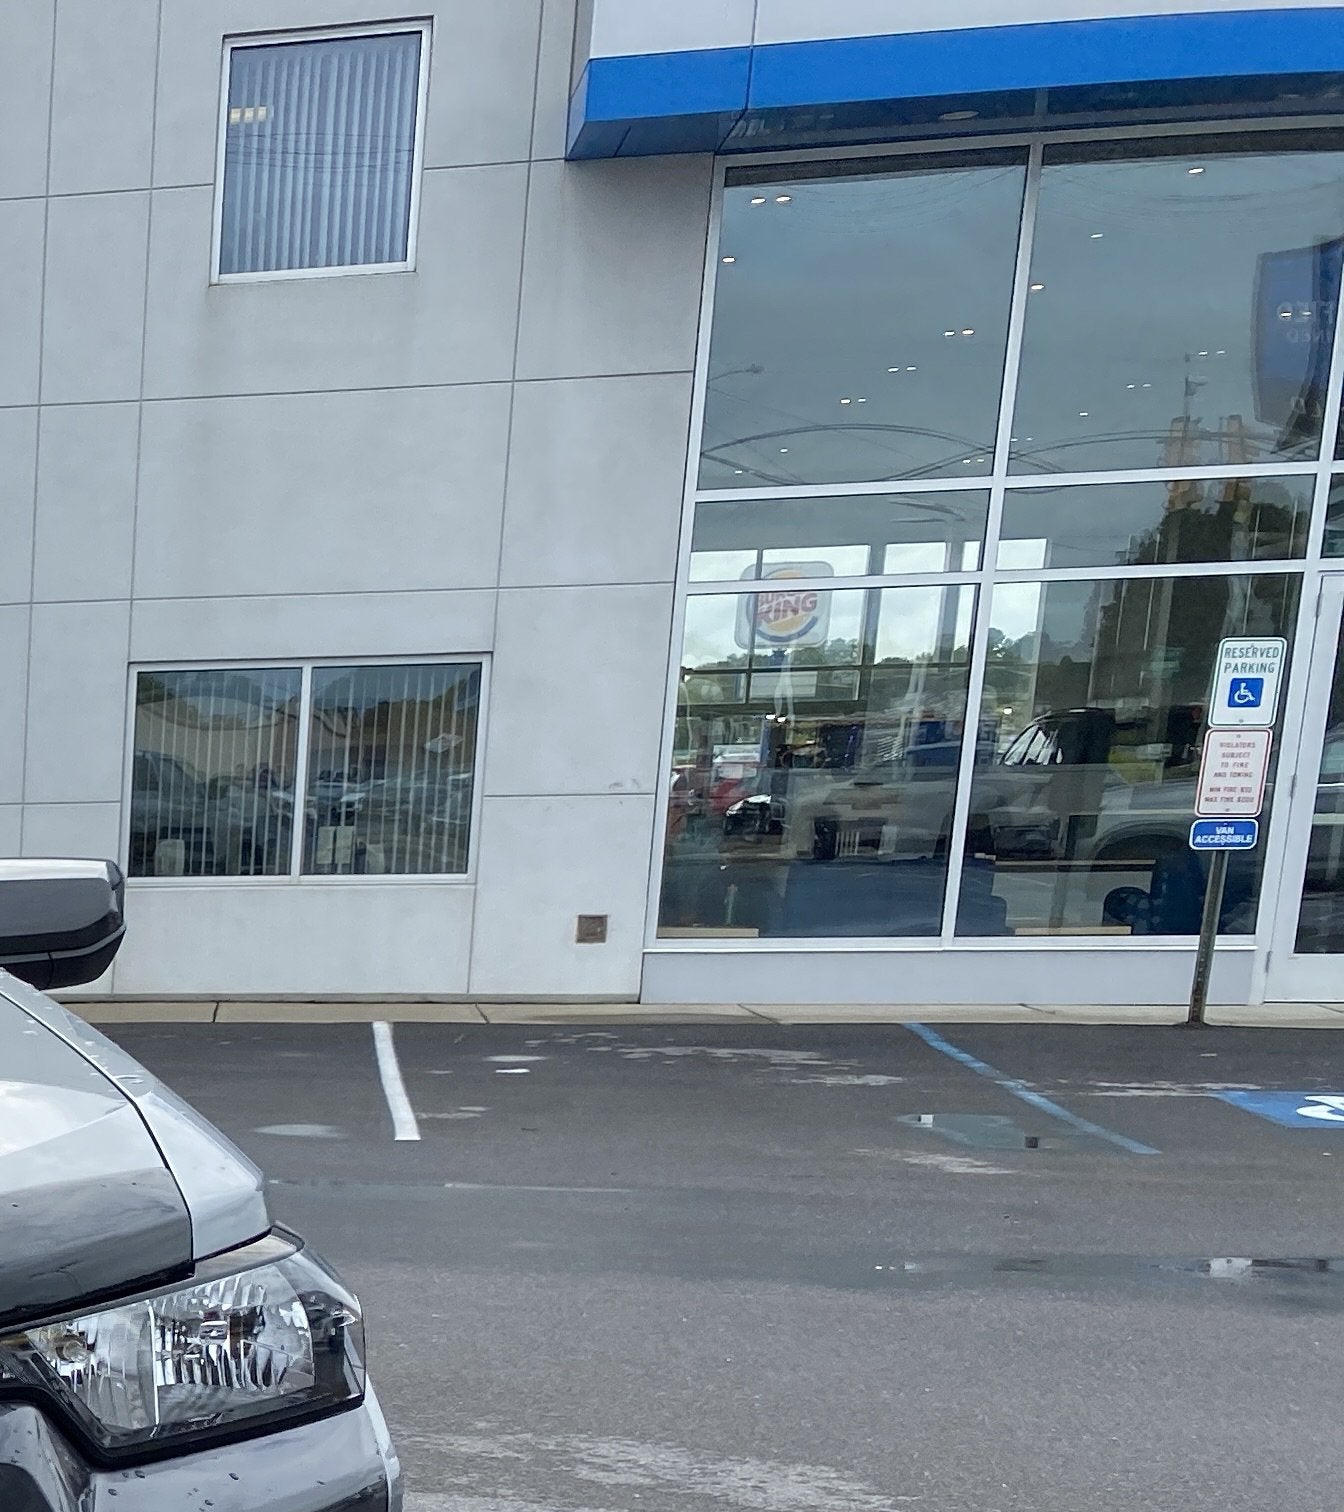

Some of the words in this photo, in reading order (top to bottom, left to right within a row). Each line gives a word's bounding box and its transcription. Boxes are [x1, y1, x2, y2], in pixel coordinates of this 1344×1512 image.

[1224, 646, 1280, 659] RESERVED
[1223, 662, 1276, 674] PARKING
[1215, 826, 1235, 835] VAN
[1194, 834, 1253, 844] ACCESSIBLE
